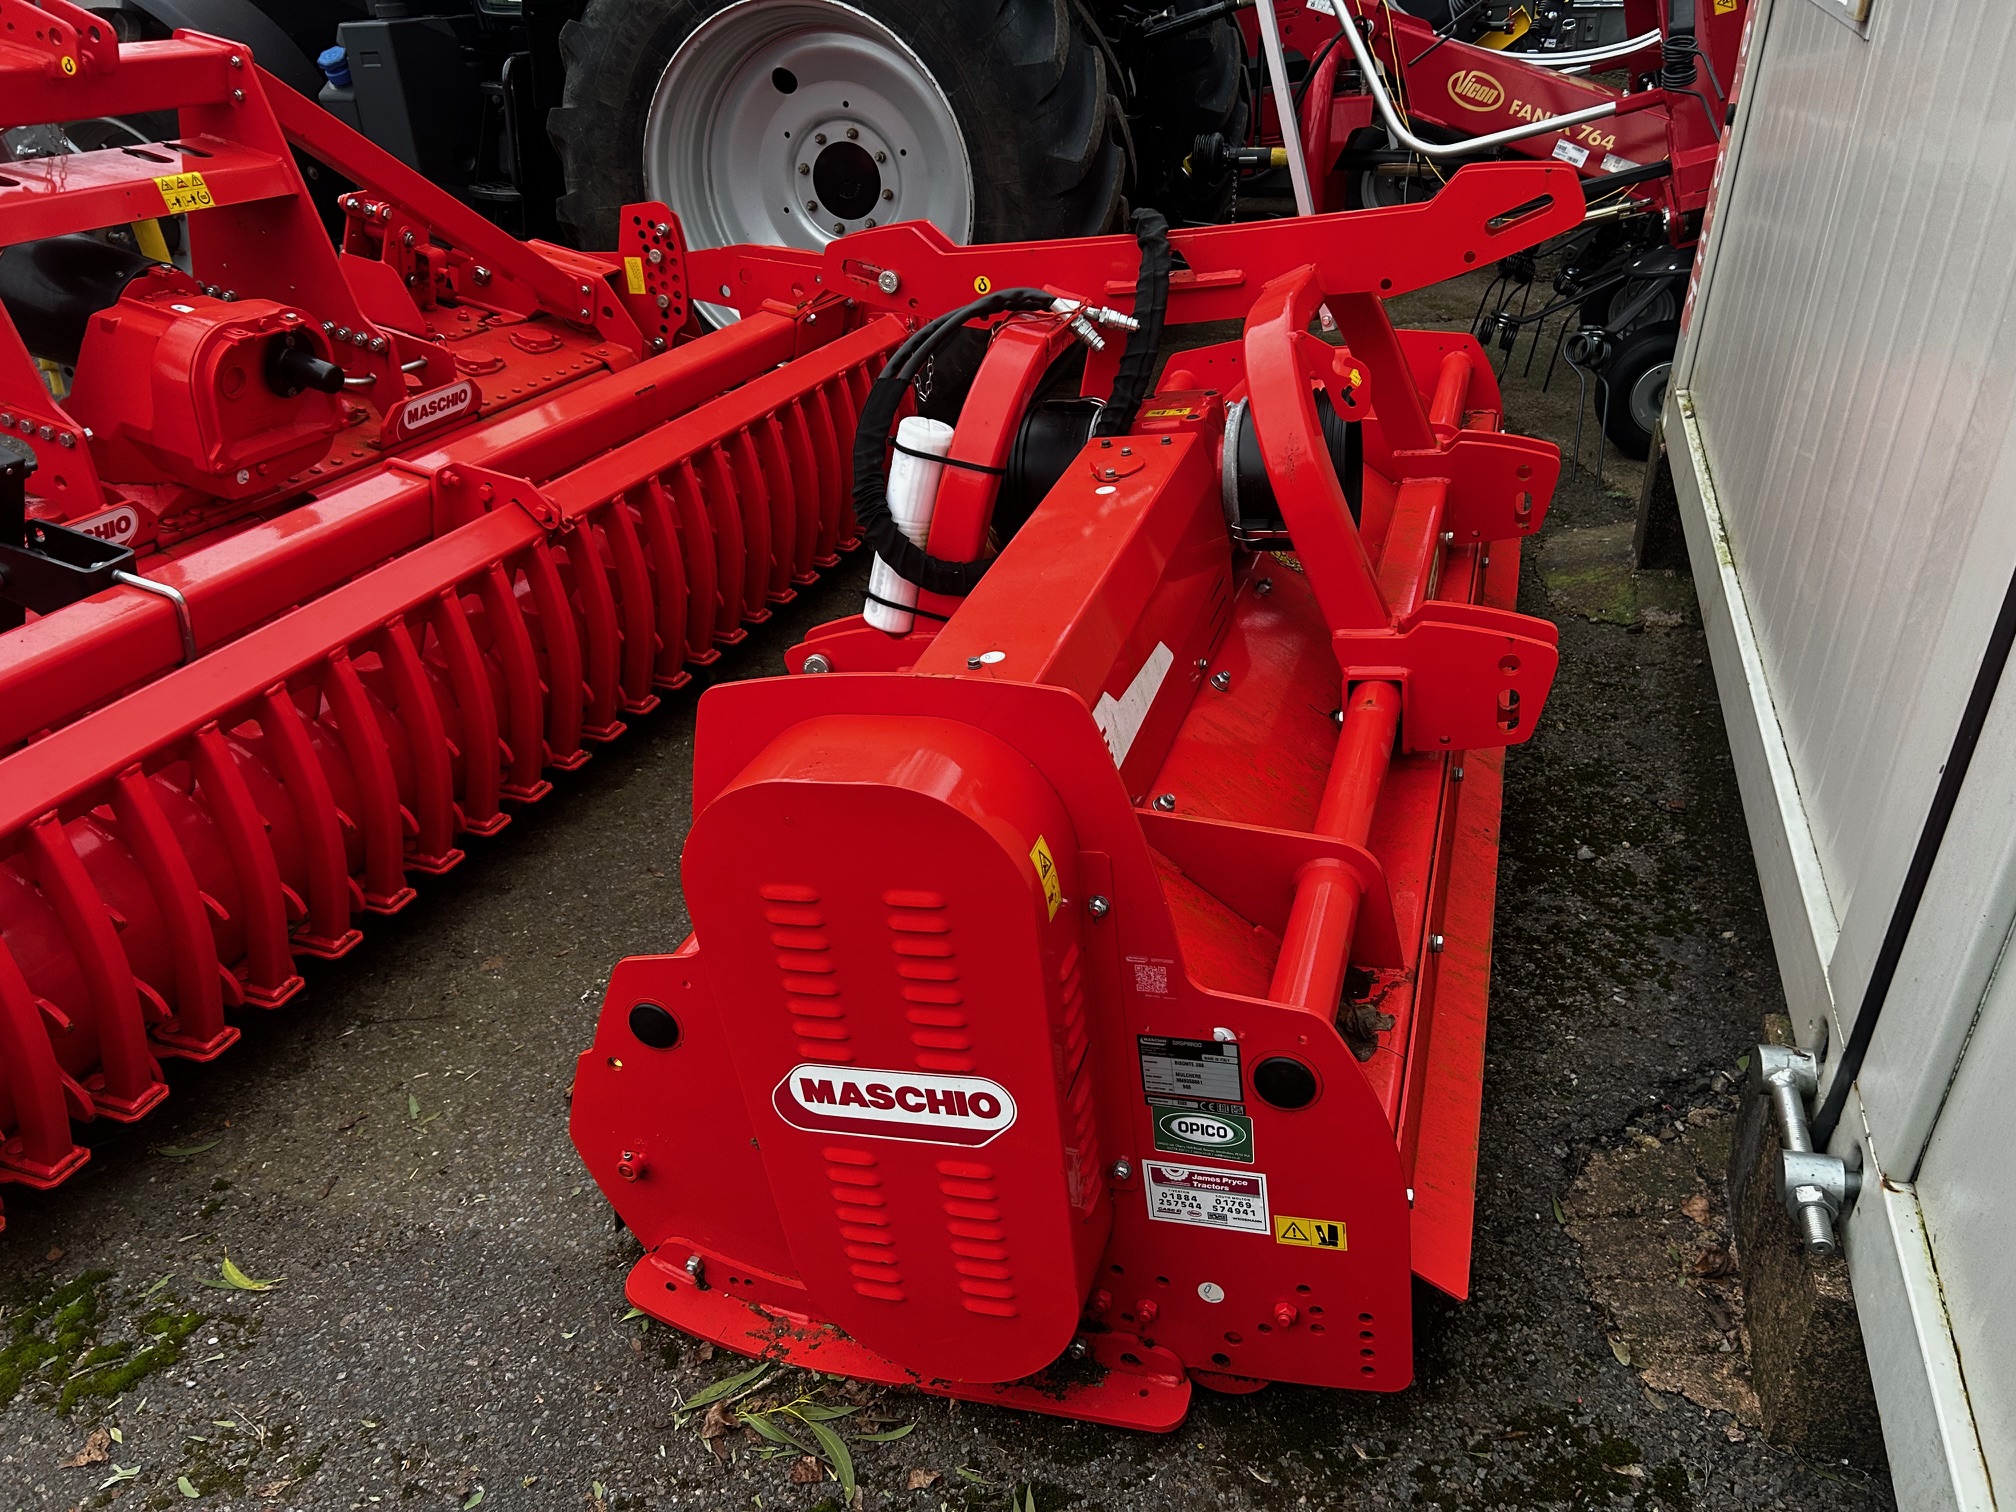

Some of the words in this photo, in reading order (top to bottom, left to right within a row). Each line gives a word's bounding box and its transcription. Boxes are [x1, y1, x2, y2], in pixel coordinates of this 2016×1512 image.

[1454, 70, 1500, 105] Vicon
[1576, 124, 1617, 151] 764
[407, 389, 468, 425] MASCHIO
[799, 1077, 1002, 1119] MASCHIO
[1177, 1121, 1228, 1139] OPICO
[1192, 1174, 1221, 1183] James
[1222, 1177, 1248, 1186] Pryce
[1192, 1181, 1230, 1191] Tractors
[1161, 1192, 1198, 1202] 01884
[1158, 1199, 1202, 1210] 257544
[1215, 1198, 1252, 1209] 01769
[1212, 1205, 1256, 1217] 574941
